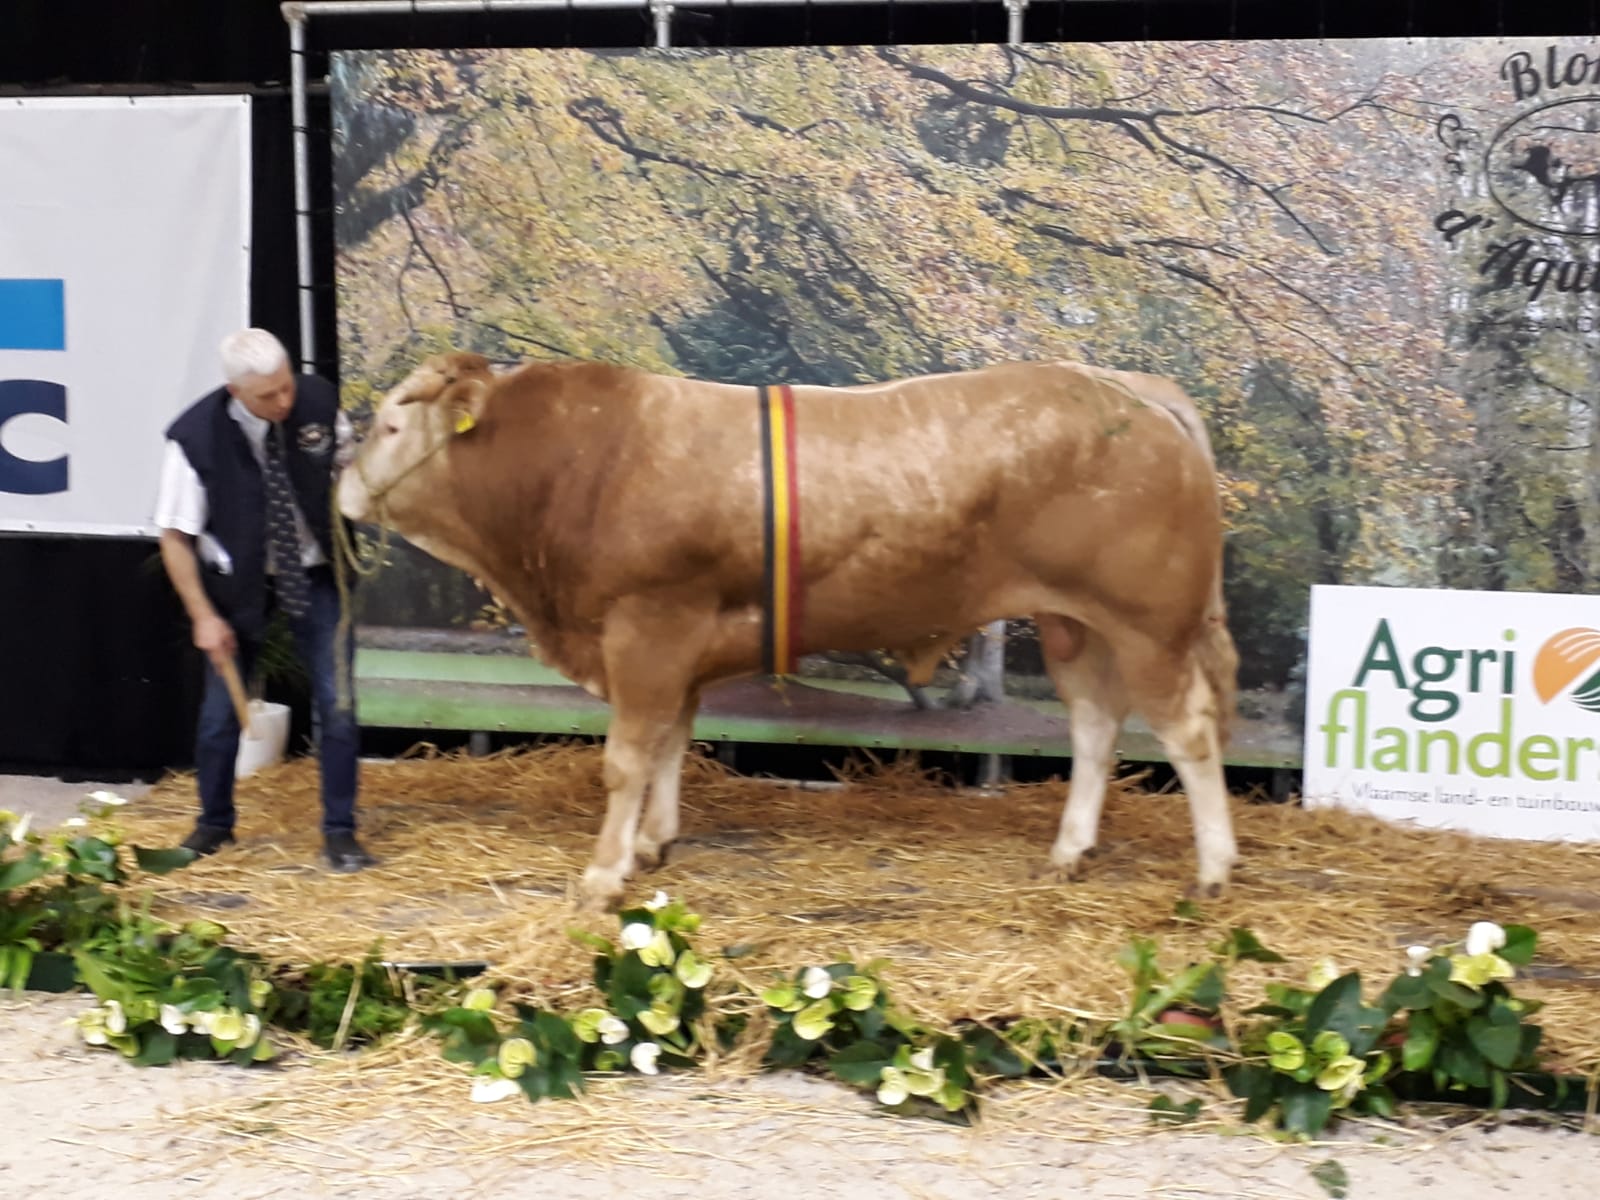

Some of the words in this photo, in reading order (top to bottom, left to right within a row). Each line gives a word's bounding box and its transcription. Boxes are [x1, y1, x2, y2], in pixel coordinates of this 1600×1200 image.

[1352, 618, 1516, 722] Agri
[1319, 688, 1600, 782] flander
[1352, 782, 1429, 803] Vlaamse
[1488, 795, 1511, 807] en
